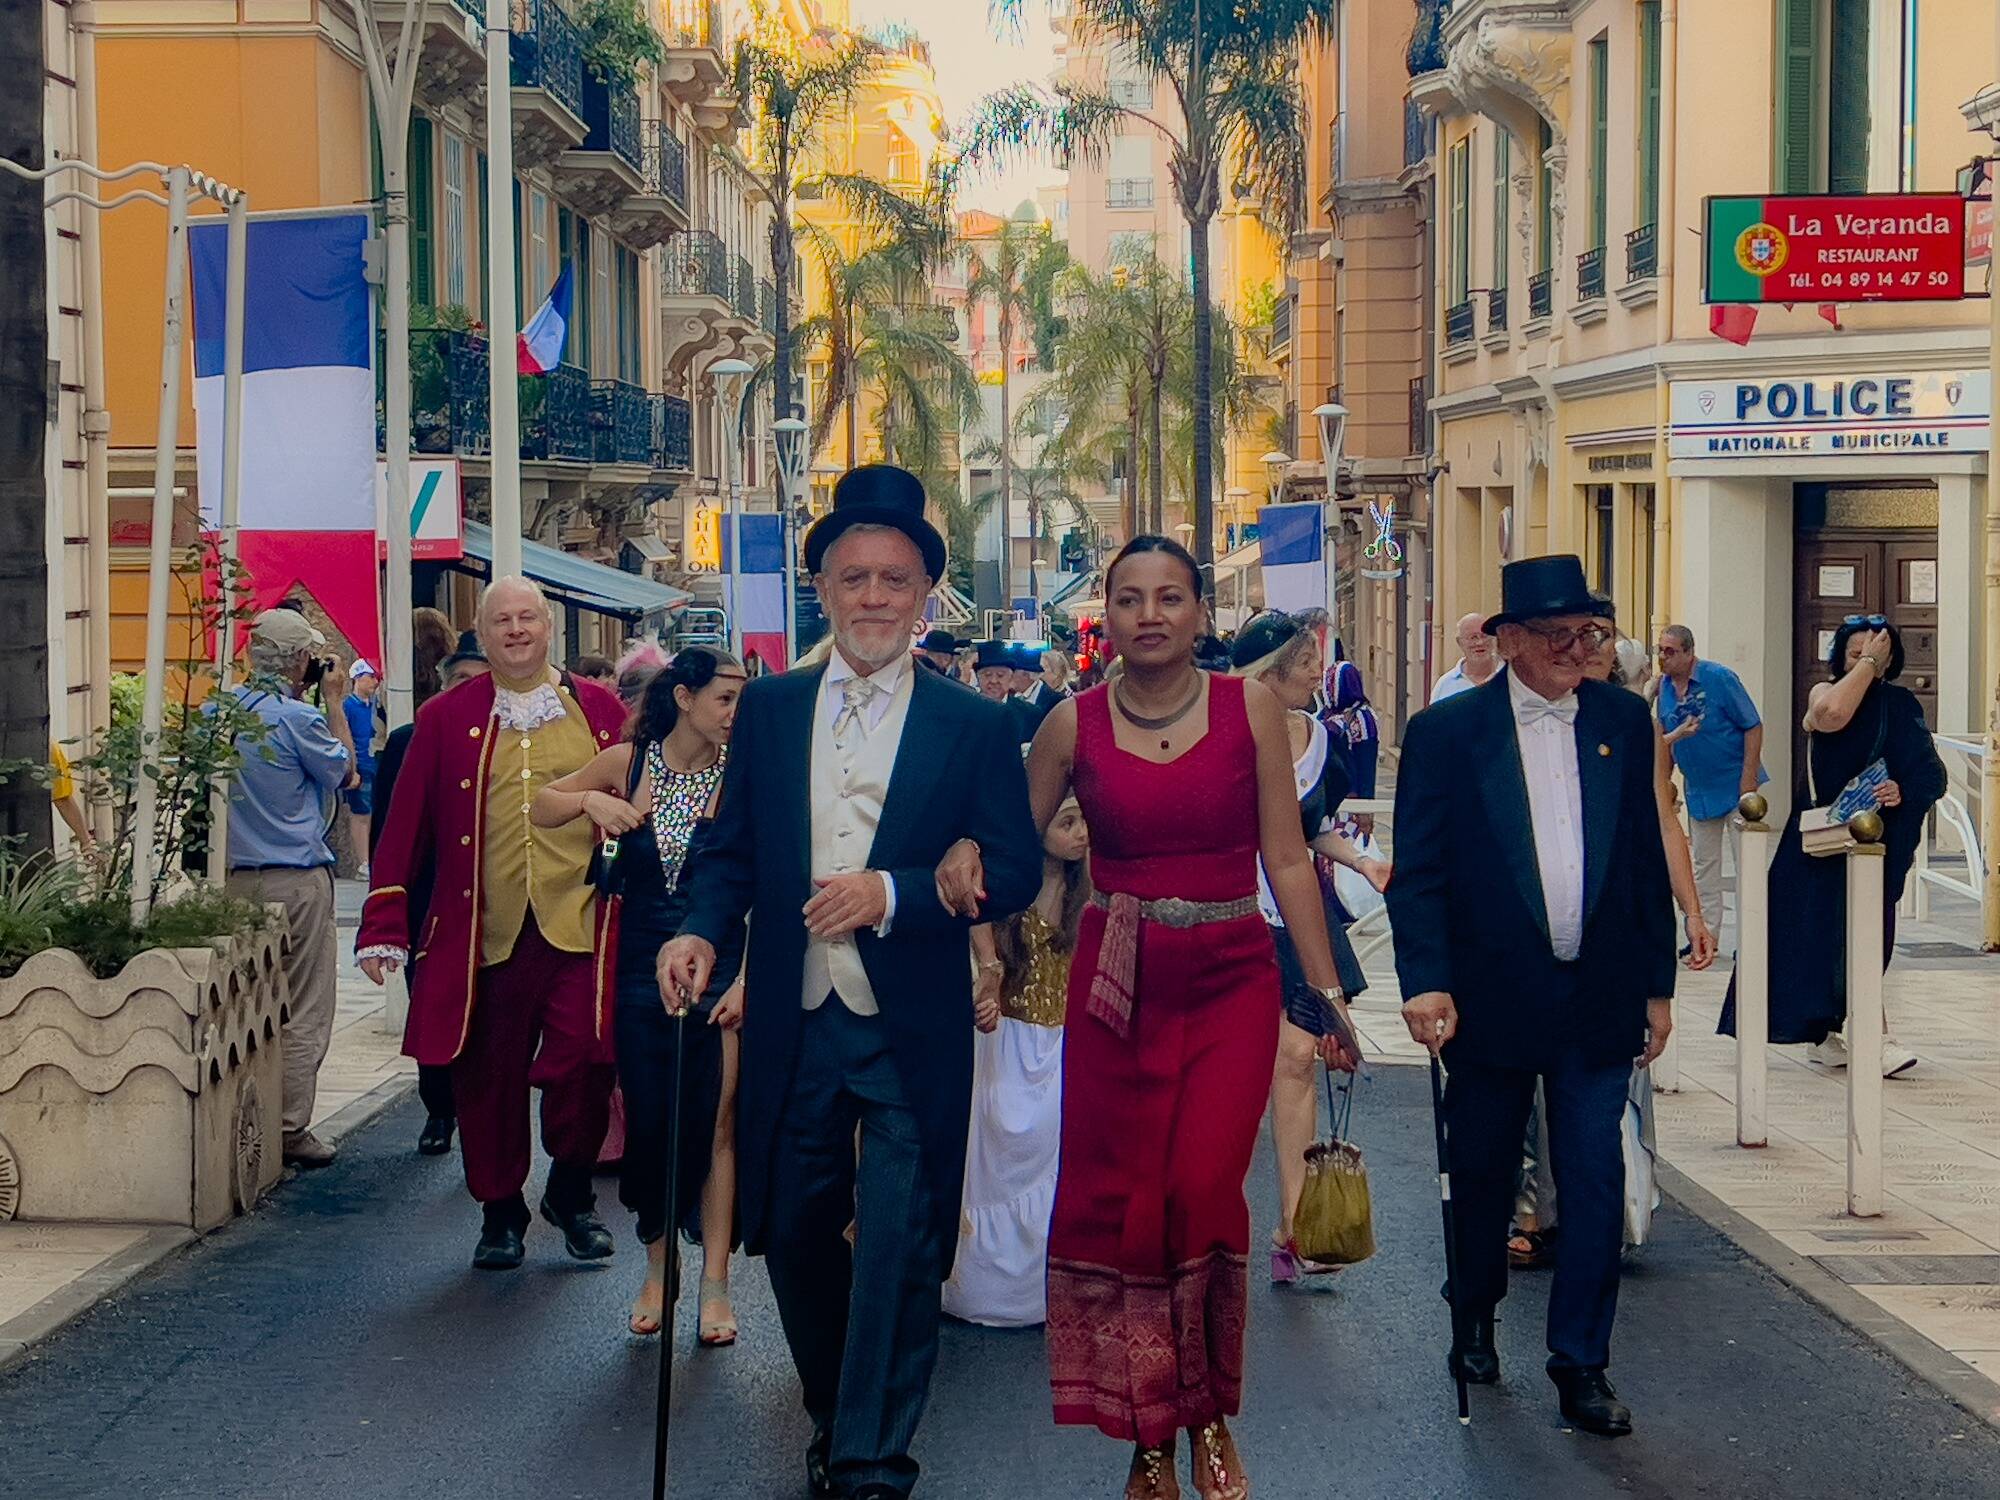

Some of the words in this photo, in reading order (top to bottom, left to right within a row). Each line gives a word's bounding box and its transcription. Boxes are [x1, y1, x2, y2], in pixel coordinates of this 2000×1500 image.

[1788, 214, 1822, 236] La
[1835, 213, 1951, 235] Veranda
[1817, 248, 1920, 264] RESTAURANT
[1821, 273, 1842, 287] 04
[1850, 273, 1871, 287] 89
[1877, 272, 1893, 286] 14
[1900, 272, 1921, 286] 47
[1928, 271, 1949, 286] 50
[1736, 379, 1912, 420] POLICE
[1709, 435, 1811, 452] NATIONALE
[1832, 432, 1949, 449] MUNICIPALE
[688, 561, 717, 572] OR
